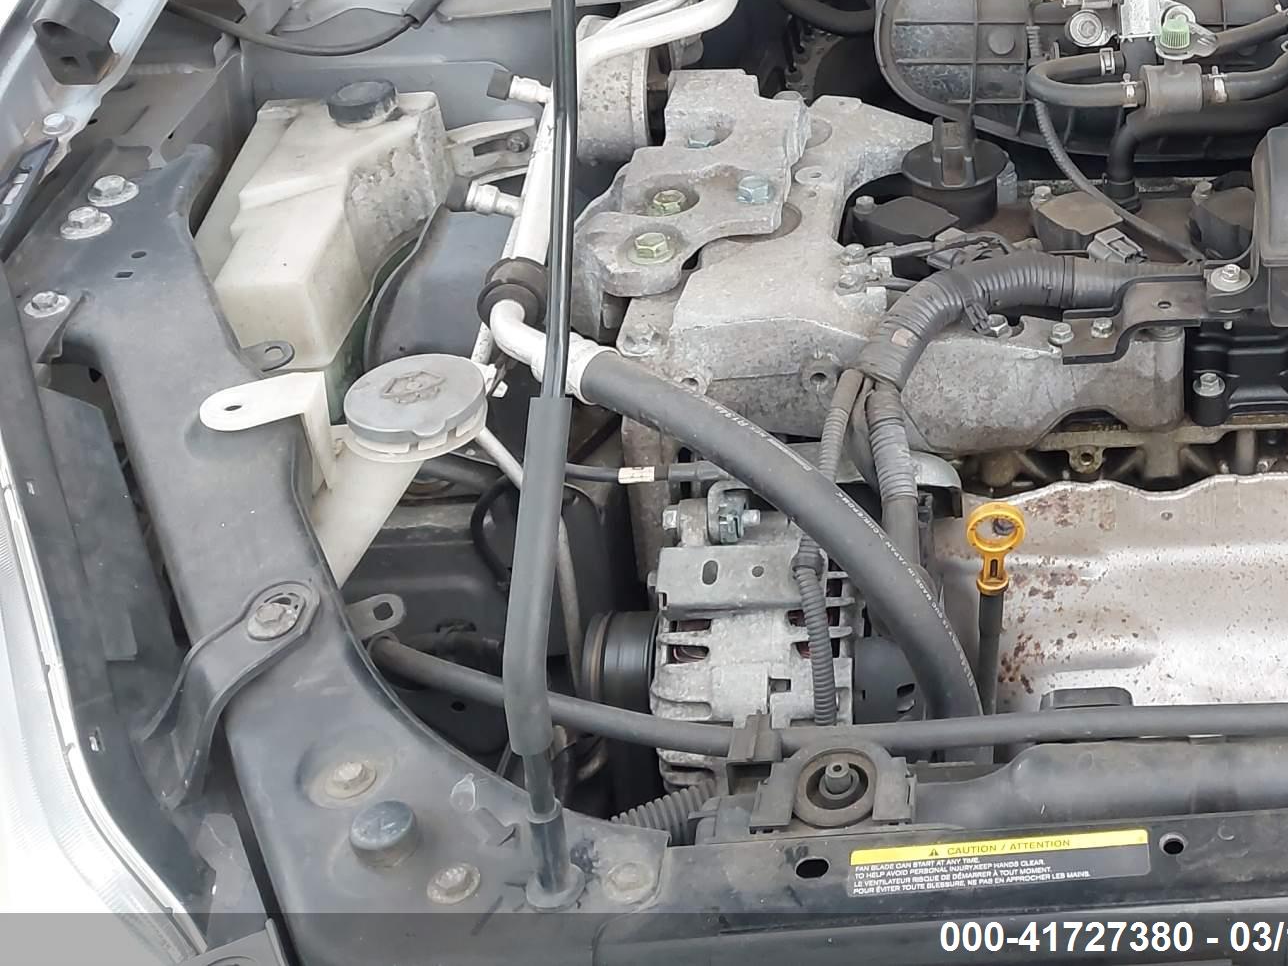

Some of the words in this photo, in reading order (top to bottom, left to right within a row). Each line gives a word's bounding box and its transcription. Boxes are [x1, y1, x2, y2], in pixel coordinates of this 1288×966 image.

[885, 541, 907, 566] JAPAN
[914, 578, 932, 601] MADE
[947, 845, 997, 855] CAUTION
[1010, 840, 1070, 851] ATTENTION
[864, 877, 911, 887] VENTILATEUR
[912, 875, 939, 883] RISQUE
[952, 871, 991, 879] DÉMARRER
[876, 885, 901, 893] ÉVITER
[1006, 874, 1050, 883] APPROCHER
